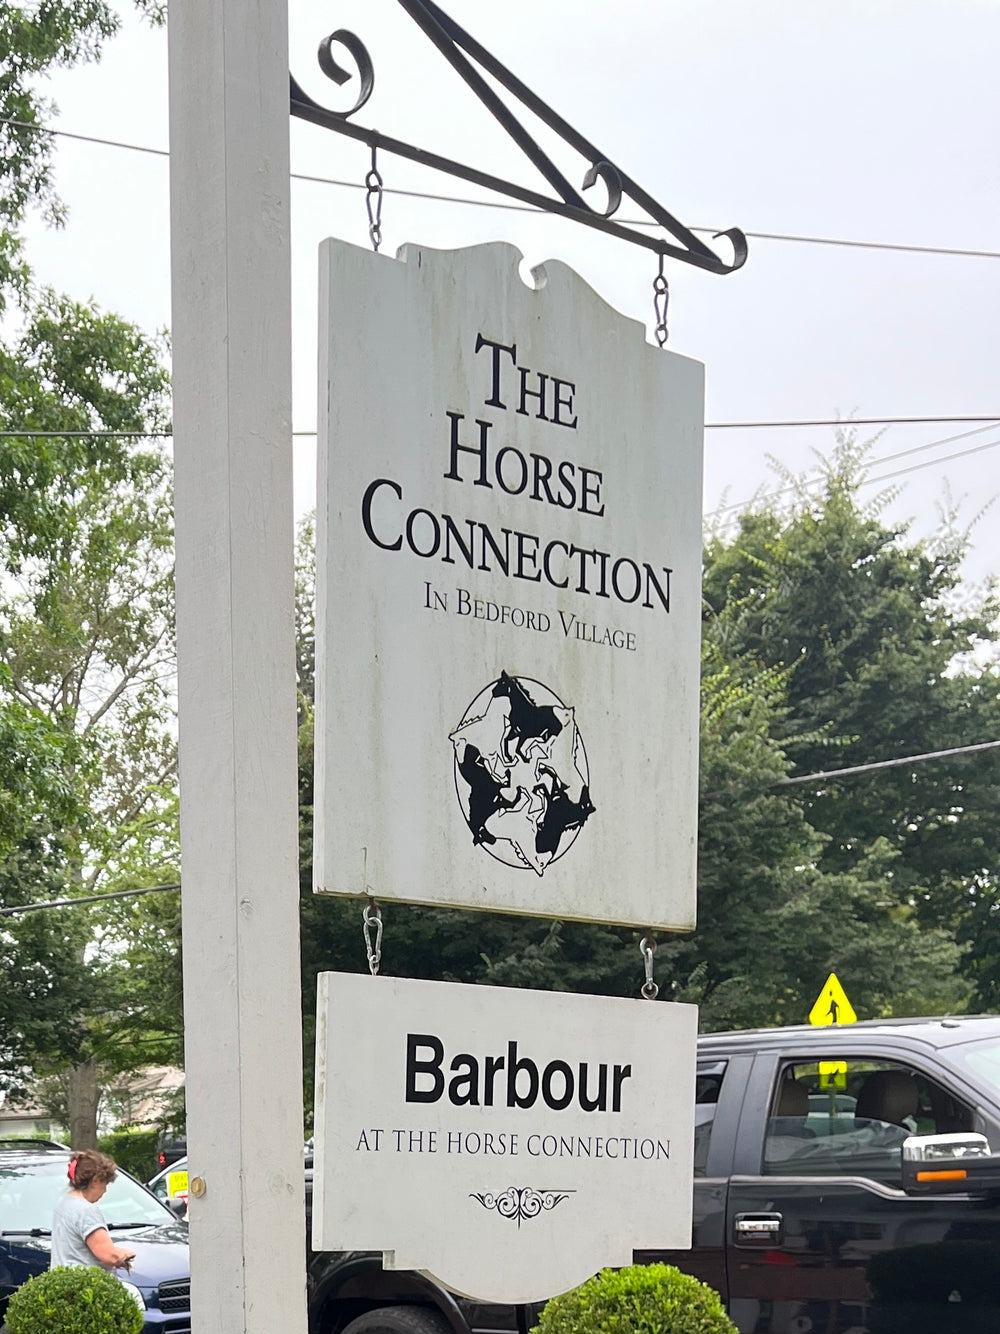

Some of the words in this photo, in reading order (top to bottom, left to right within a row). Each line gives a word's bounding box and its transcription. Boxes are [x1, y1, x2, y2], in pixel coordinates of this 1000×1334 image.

[474, 332, 578, 430] THE
[443, 410, 606, 518] HORSE
[361, 478, 674, 614] CONNECTION
[423, 581, 448, 613] IN
[455, 588, 551, 633] BEDFORD
[557, 609, 637, 652] VILLAGE
[405, 1033, 632, 1113] Barbour
[355, 1128, 385, 1153] AT
[391, 1129, 438, 1154] THE
[447, 1131, 519, 1156] HORSE
[526, 1134, 671, 1160] CONNECTION
